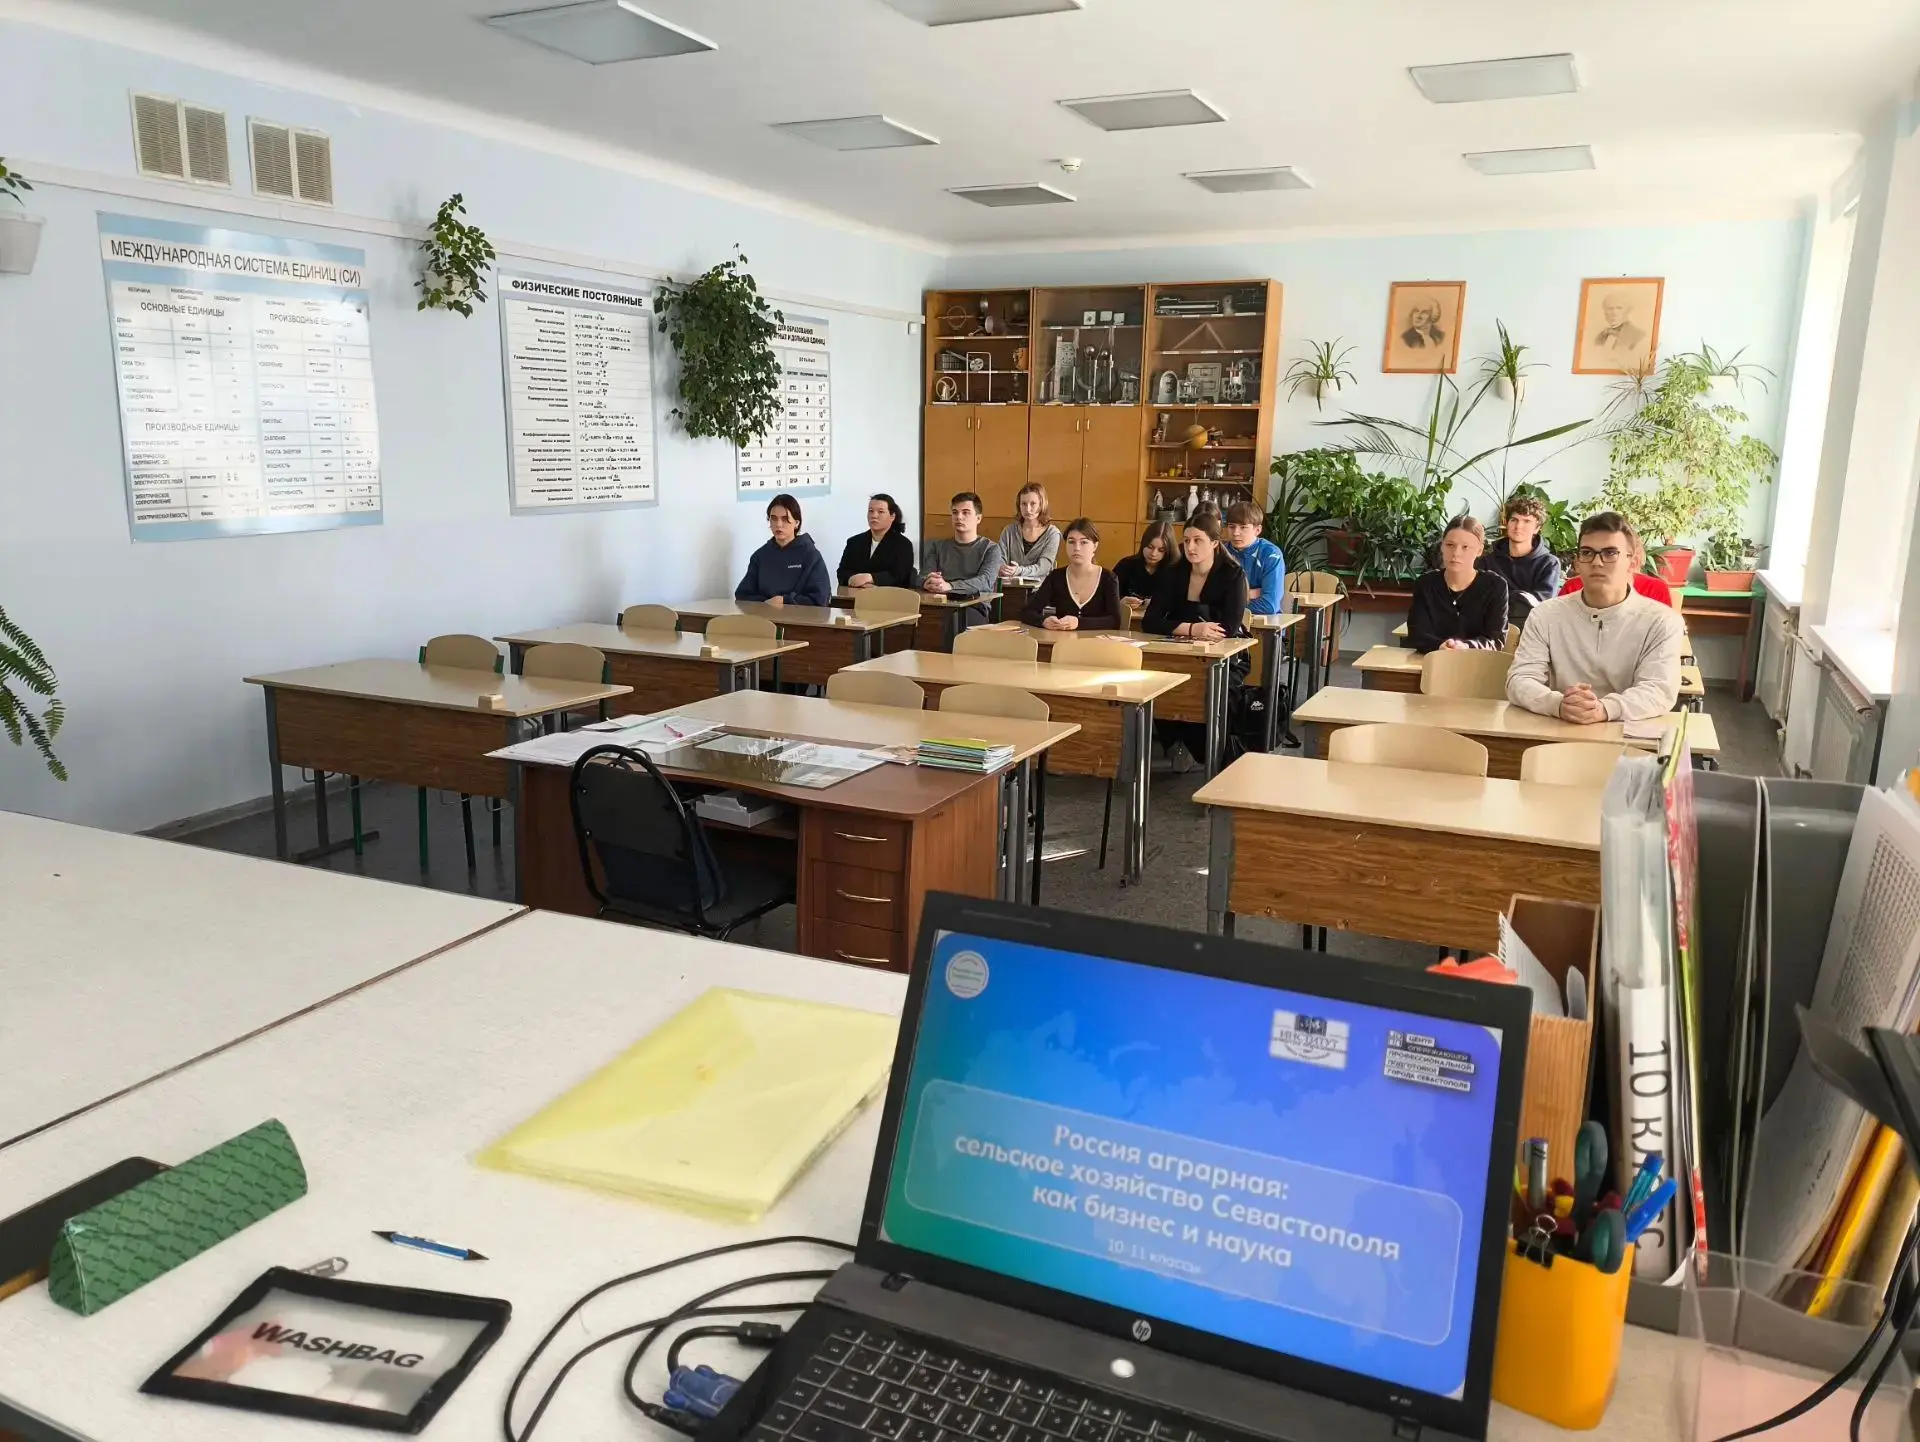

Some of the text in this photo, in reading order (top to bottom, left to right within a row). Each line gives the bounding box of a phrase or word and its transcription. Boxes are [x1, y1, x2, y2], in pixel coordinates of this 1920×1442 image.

[111, 239, 361, 286] МЕЖДУНАРОДНАЯ СИСТЕМА ЕДИНИЦ (СИ)
[512, 279, 643, 307] ФИЗИЧЕСКИЕ ПОСТОЯННЫЕ
[140, 302, 224, 317] ОСНОВНЫЕ ЕДИНИЦЫ
[145, 422, 240, 432] ПРОИЗВОДНЫЕ ЕДИНИЦЫ
[1409, 1035, 1433, 1044] ЦЕНТР
[1388, 1050, 1472, 1071] ПРОФЕССИОНАЛЬНОЙ
[1387, 1069, 1468, 1089] ГОРОДА СЕВАСТОПОЛЯ
[1629, 1040, 1671, 1249] 10 КЛС
[1054, 1124, 1290, 1200] Россия аграрная:
[955, 1136, 1400, 1261] сельское хозяйство Севастополя
[1032, 1185, 1292, 1268] как бизнес и наука
[1133, 1320, 1151, 1340] hp
[251, 1322, 424, 1368] WASHBAG
